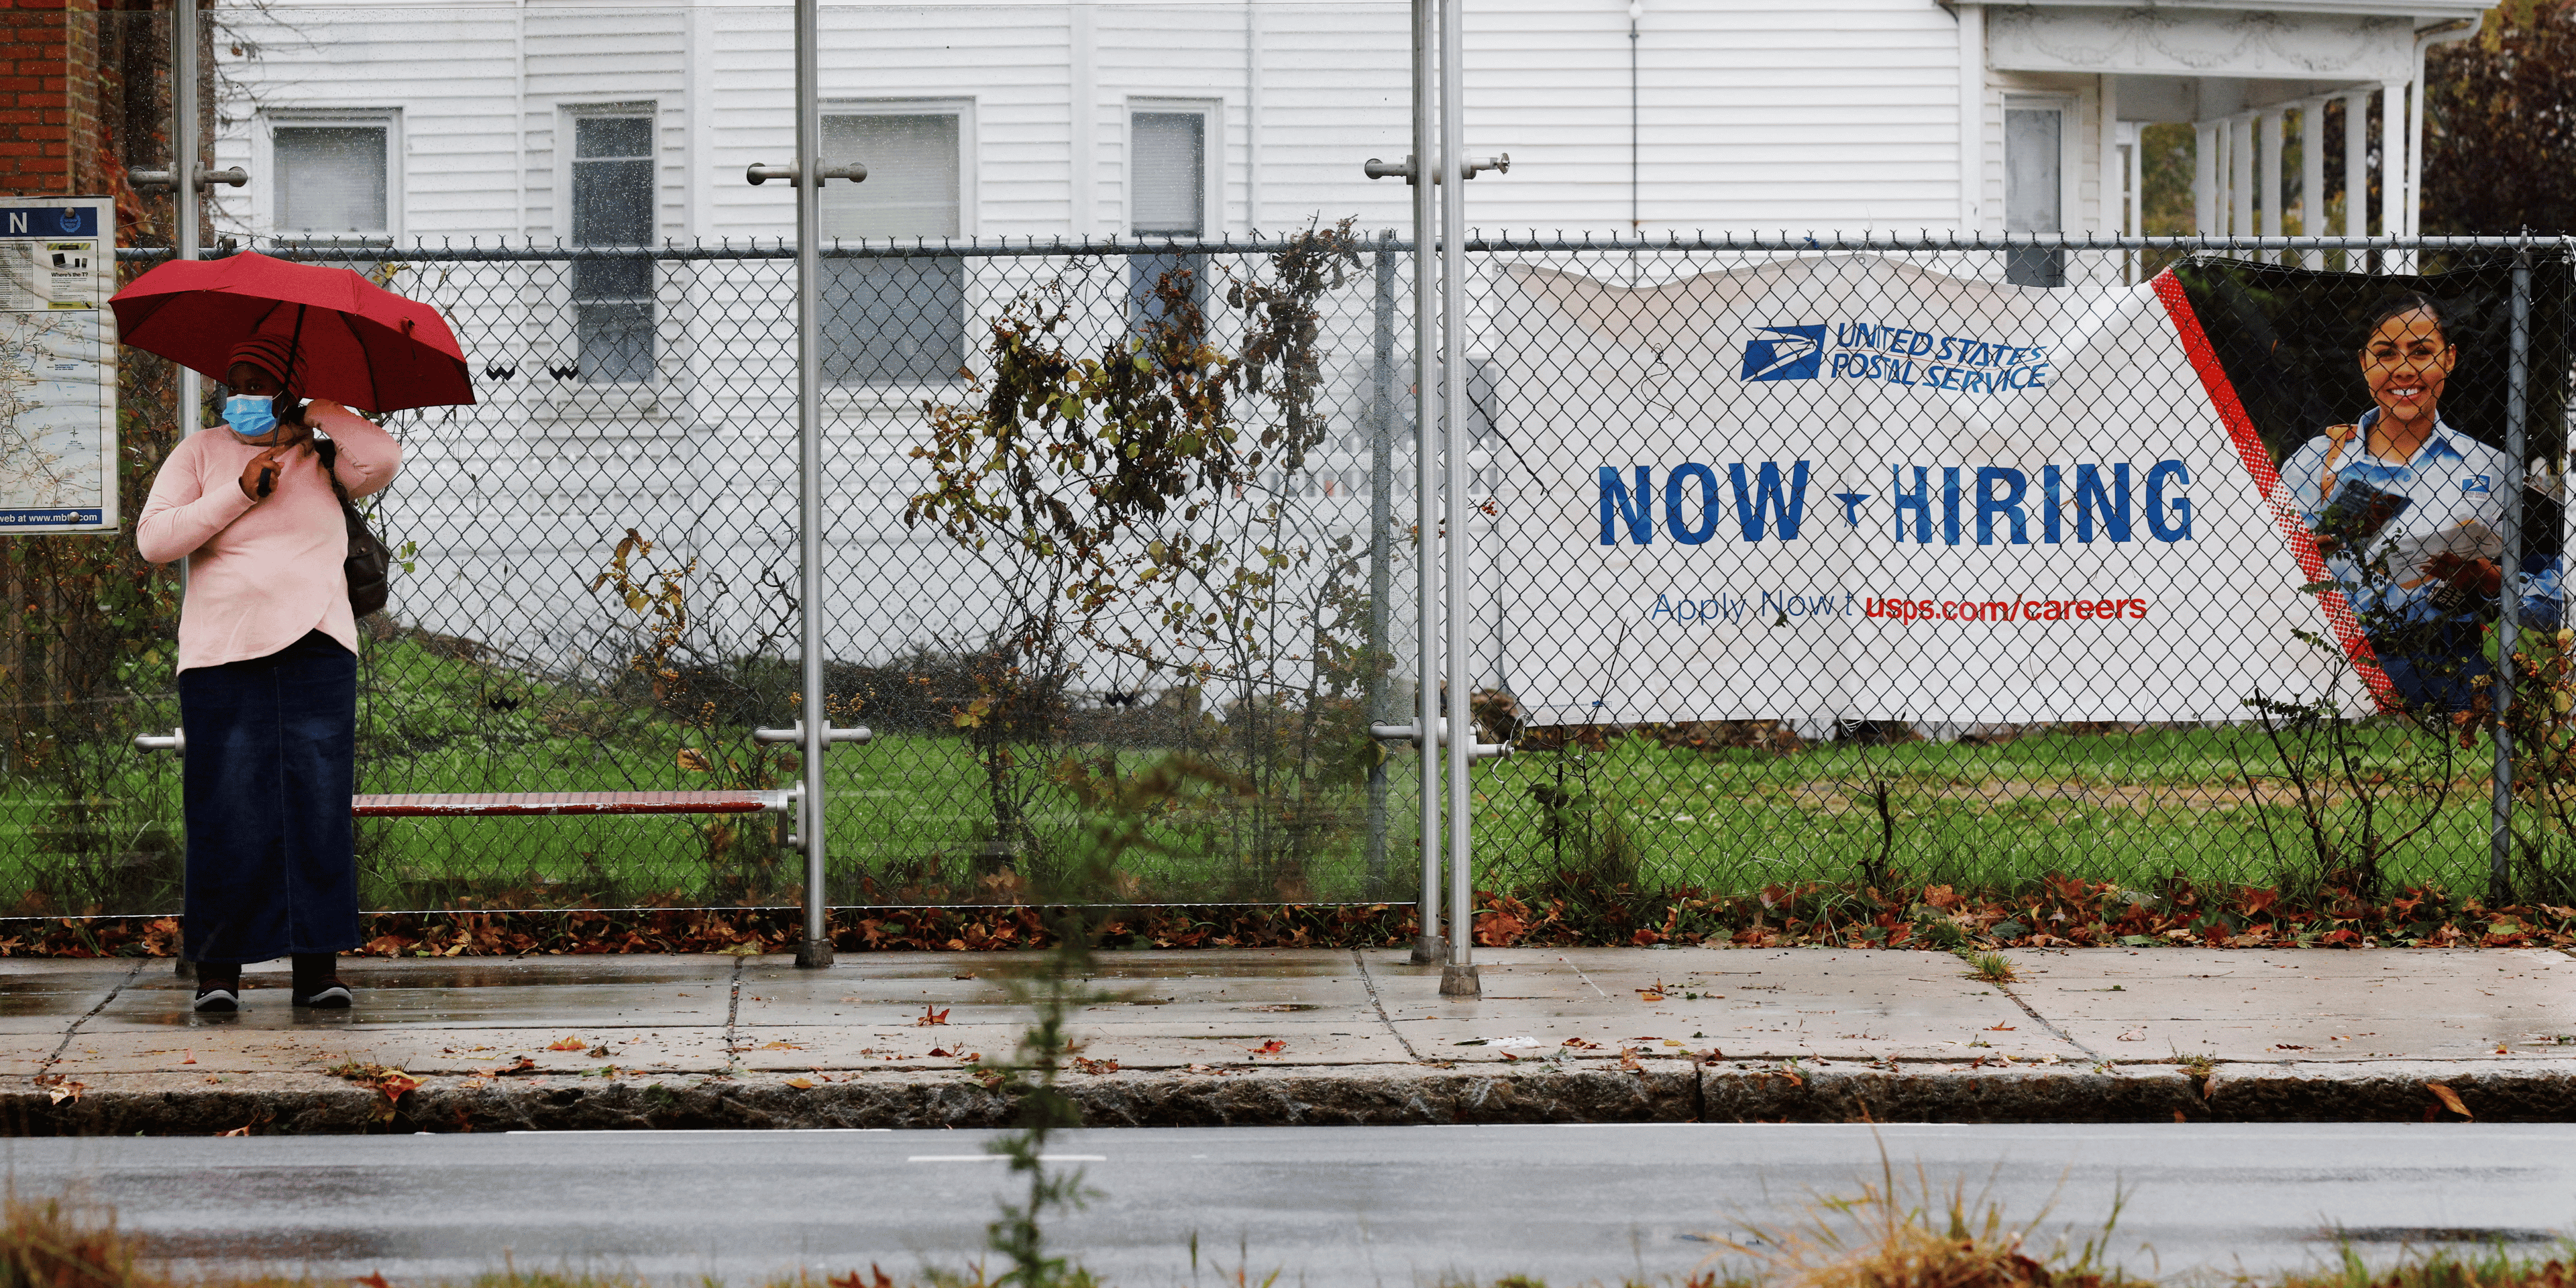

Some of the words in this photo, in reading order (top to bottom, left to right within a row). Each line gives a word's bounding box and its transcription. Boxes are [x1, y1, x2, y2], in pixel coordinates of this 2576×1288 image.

[9, 212, 28, 233] N
[1837, 323, 1933, 356] UNITED
[1937, 337, 2048, 367] STATES
[1831, 353, 1915, 386] POSTAL
[1922, 363, 2049, 394] SERVICE
[17, 515, 27, 523] at
[29, 513, 97, 522] www.mbtcom
[1599, 460, 1811, 547] NOW
[1892, 460, 2193, 546] HIRING
[1652, 592, 1746, 626] Apply
[1762, 590, 1835, 616] Now
[1866, 594, 2147, 625] usps.com/careers
